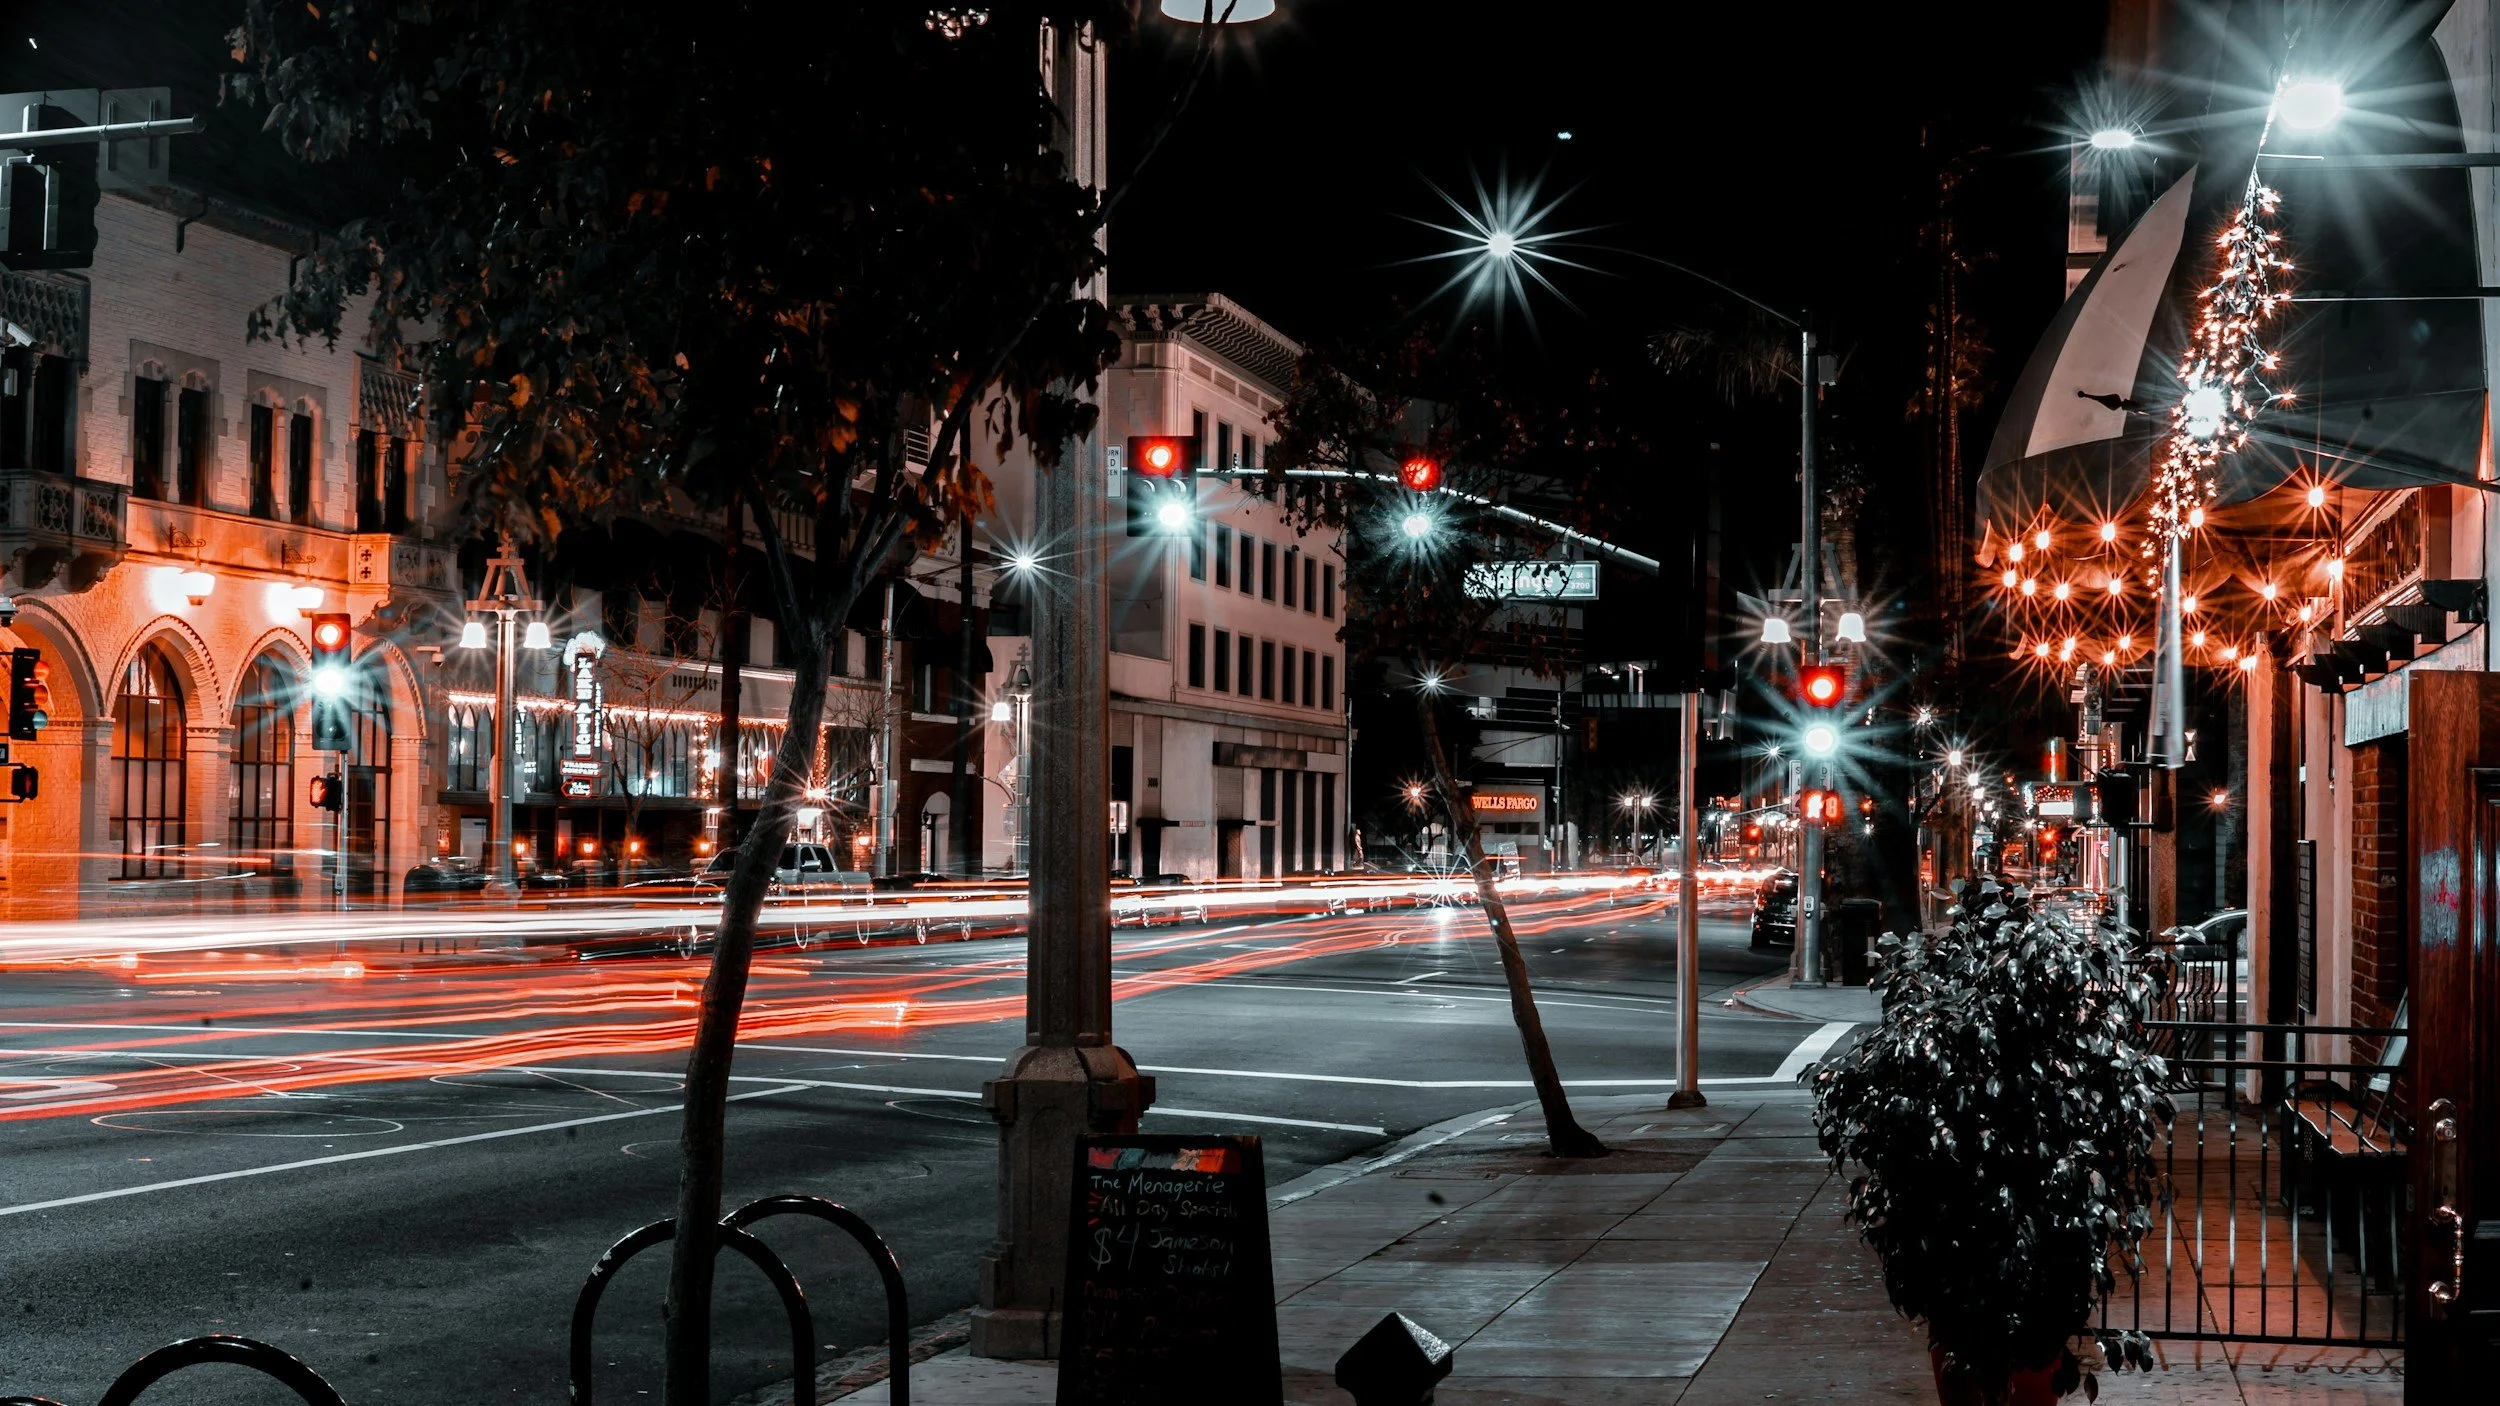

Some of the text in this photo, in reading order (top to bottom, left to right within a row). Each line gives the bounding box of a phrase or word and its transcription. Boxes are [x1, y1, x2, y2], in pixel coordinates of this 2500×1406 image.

[574, 657, 593, 755] LAKE ALICE
[1471, 796, 1538, 810] WELLS FARGO
[1091, 1174, 1225, 1202] The Menagerie
[1099, 1196, 1126, 1216] All
[1136, 1200, 1170, 1223] Day
[1148, 1228, 1235, 1256] Jameson
